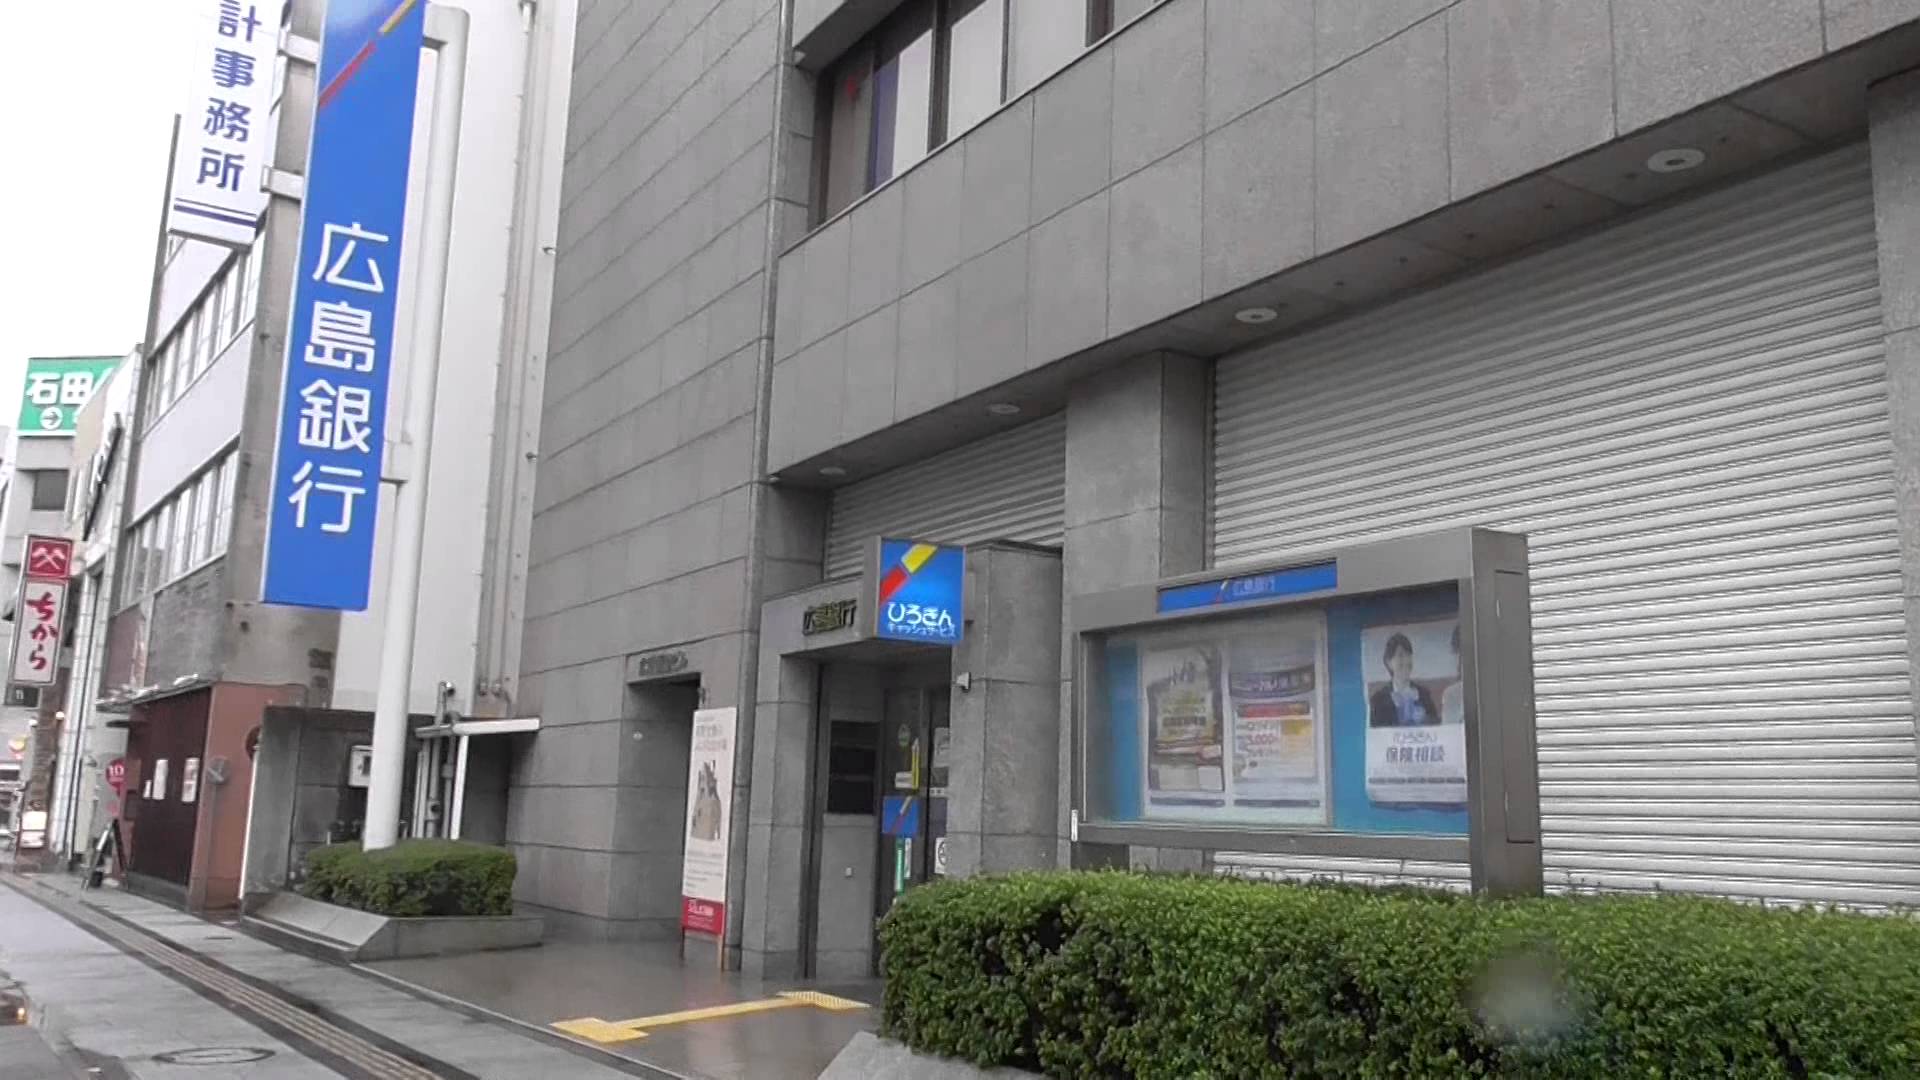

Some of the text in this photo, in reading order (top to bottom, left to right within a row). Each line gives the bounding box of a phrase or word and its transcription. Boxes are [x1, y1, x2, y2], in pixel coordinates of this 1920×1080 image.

[289, 222, 389, 534] 広島銀行
[26, 592, 58, 670] ちから
[888, 602, 951, 626] ひろぎん
